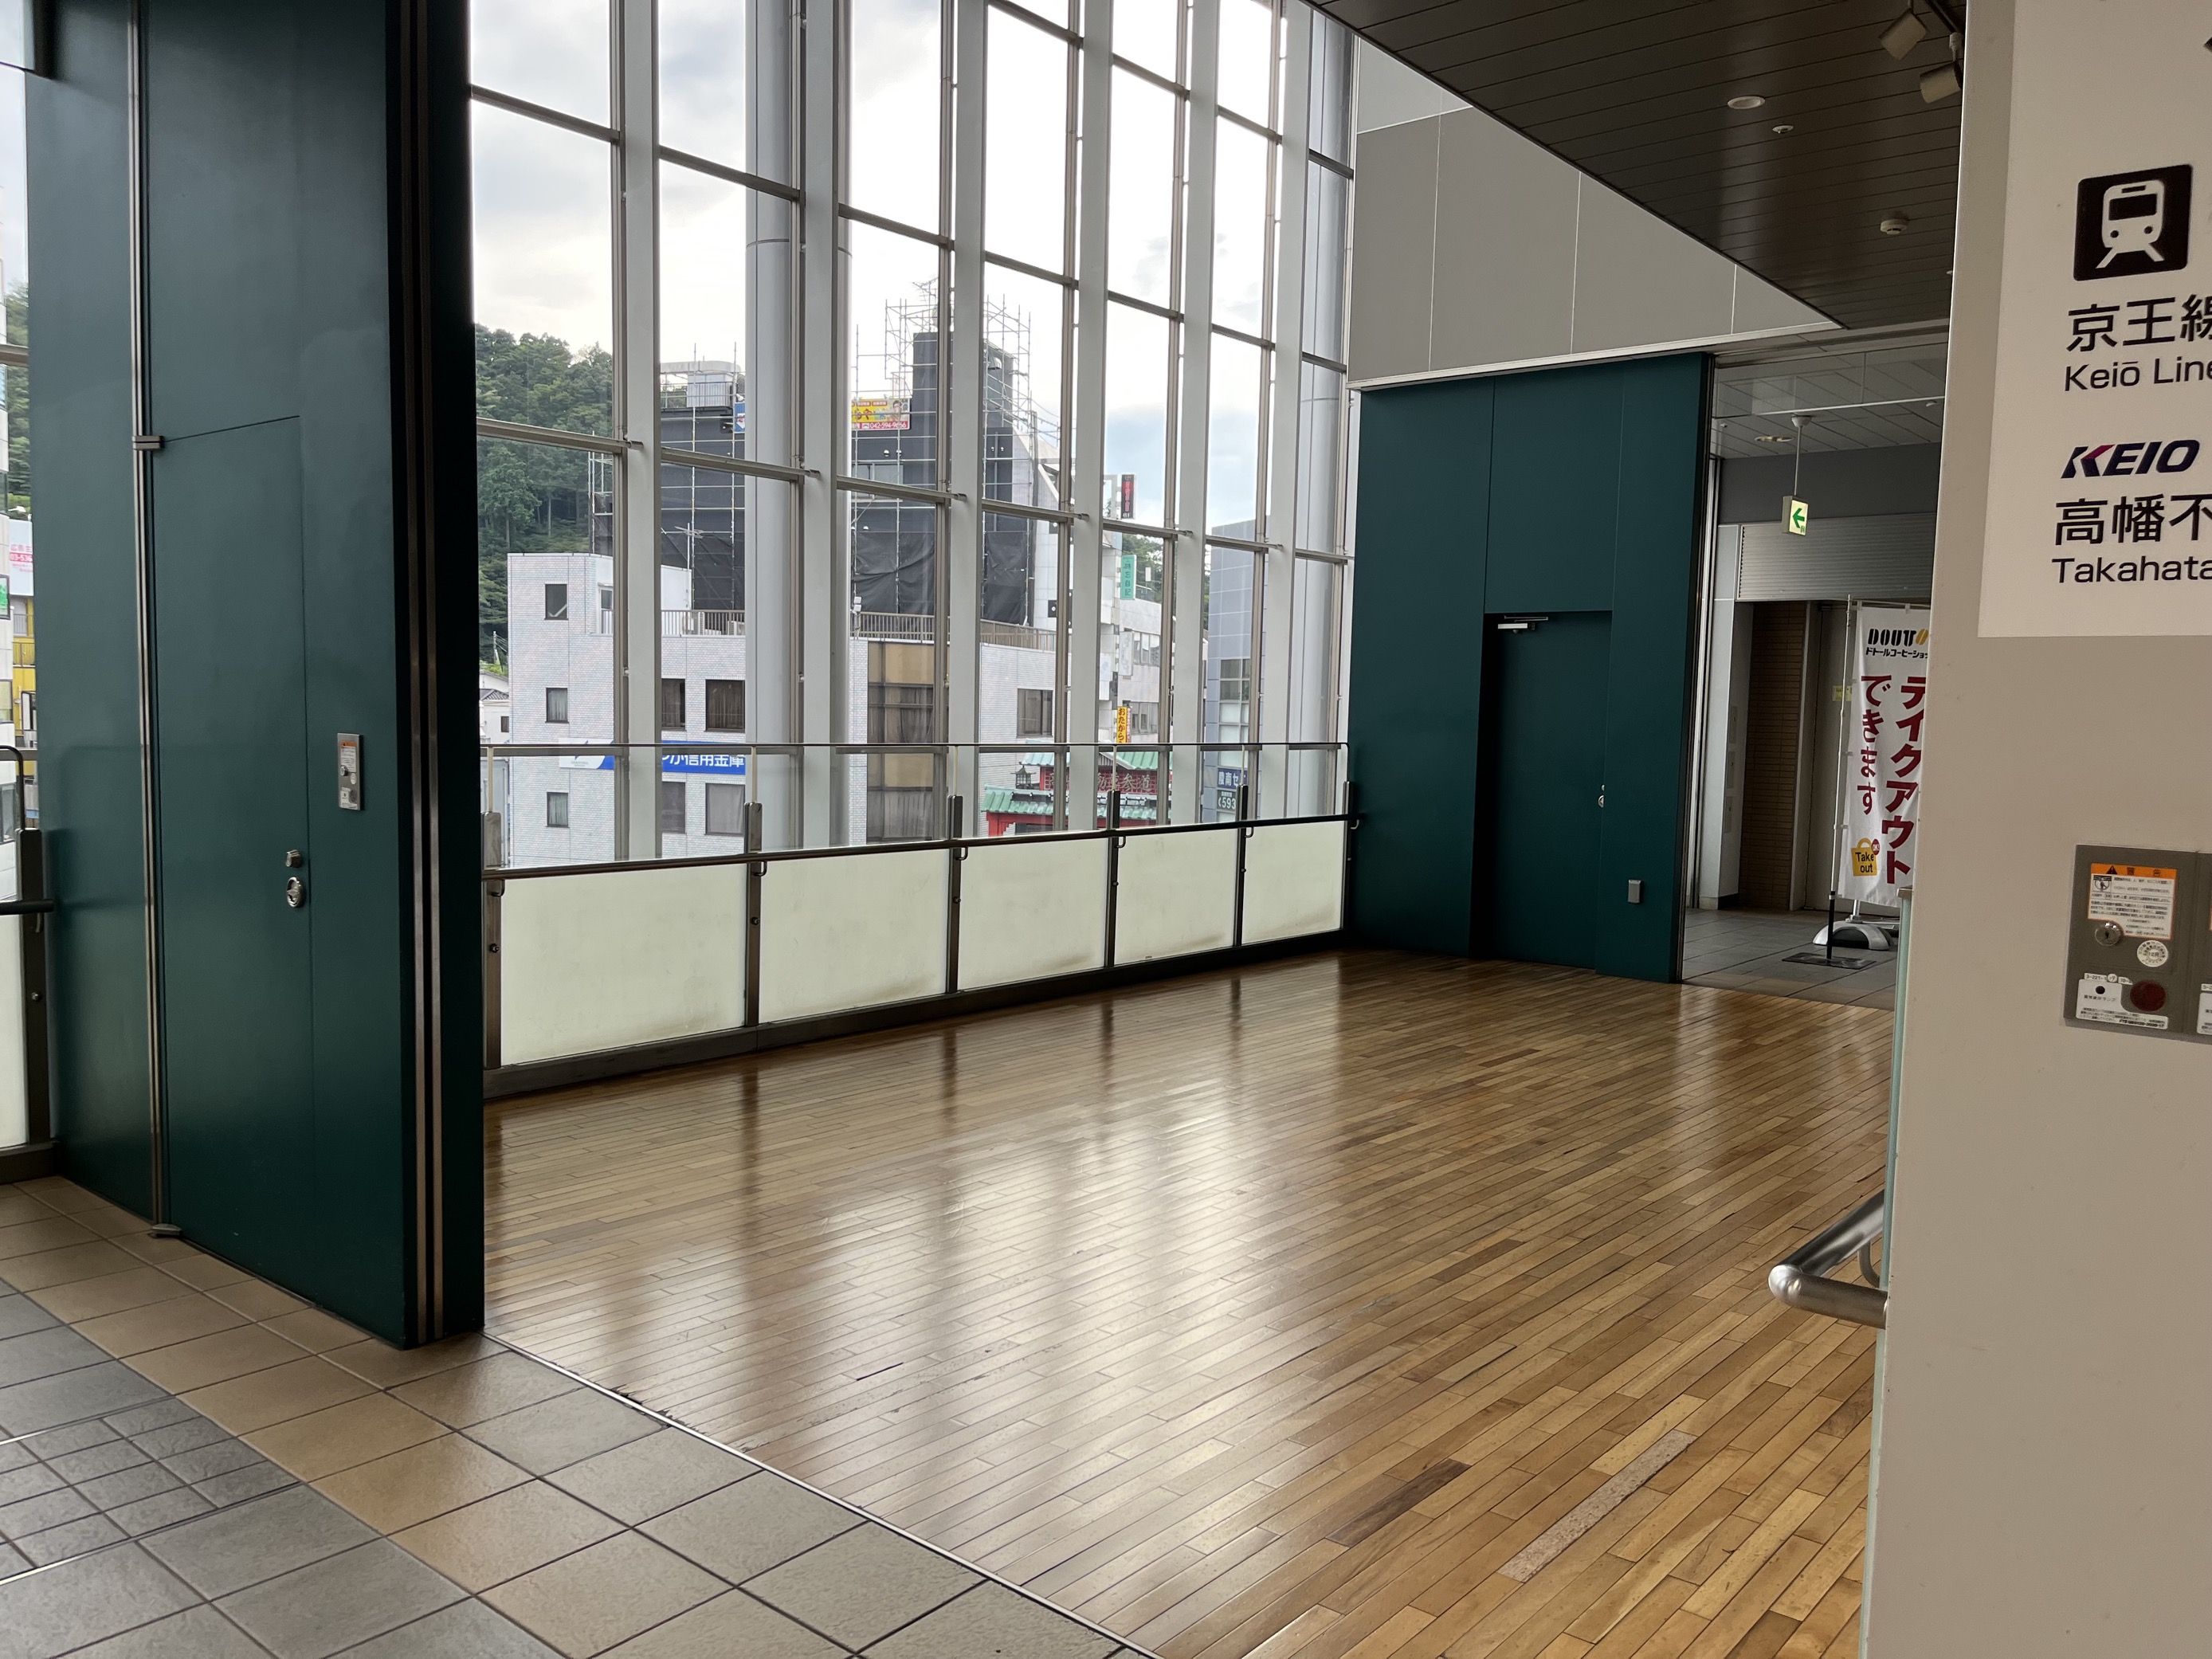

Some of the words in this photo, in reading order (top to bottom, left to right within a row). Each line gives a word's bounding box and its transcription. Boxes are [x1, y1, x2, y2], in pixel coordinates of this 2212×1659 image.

[2066, 294, 2212, 351] 京王線
[2065, 361, 2140, 391] Keiō
[2061, 440, 2200, 479] KEIO
[2055, 493, 2212, 546] 高幡不
[2052, 555, 2212, 583] Takahata
[1857, 675, 1892, 814] できます
[1881, 677, 1926, 884] テイクアウト
[1855, 852, 1874, 862] Take
[1860, 864, 1873, 873] out
